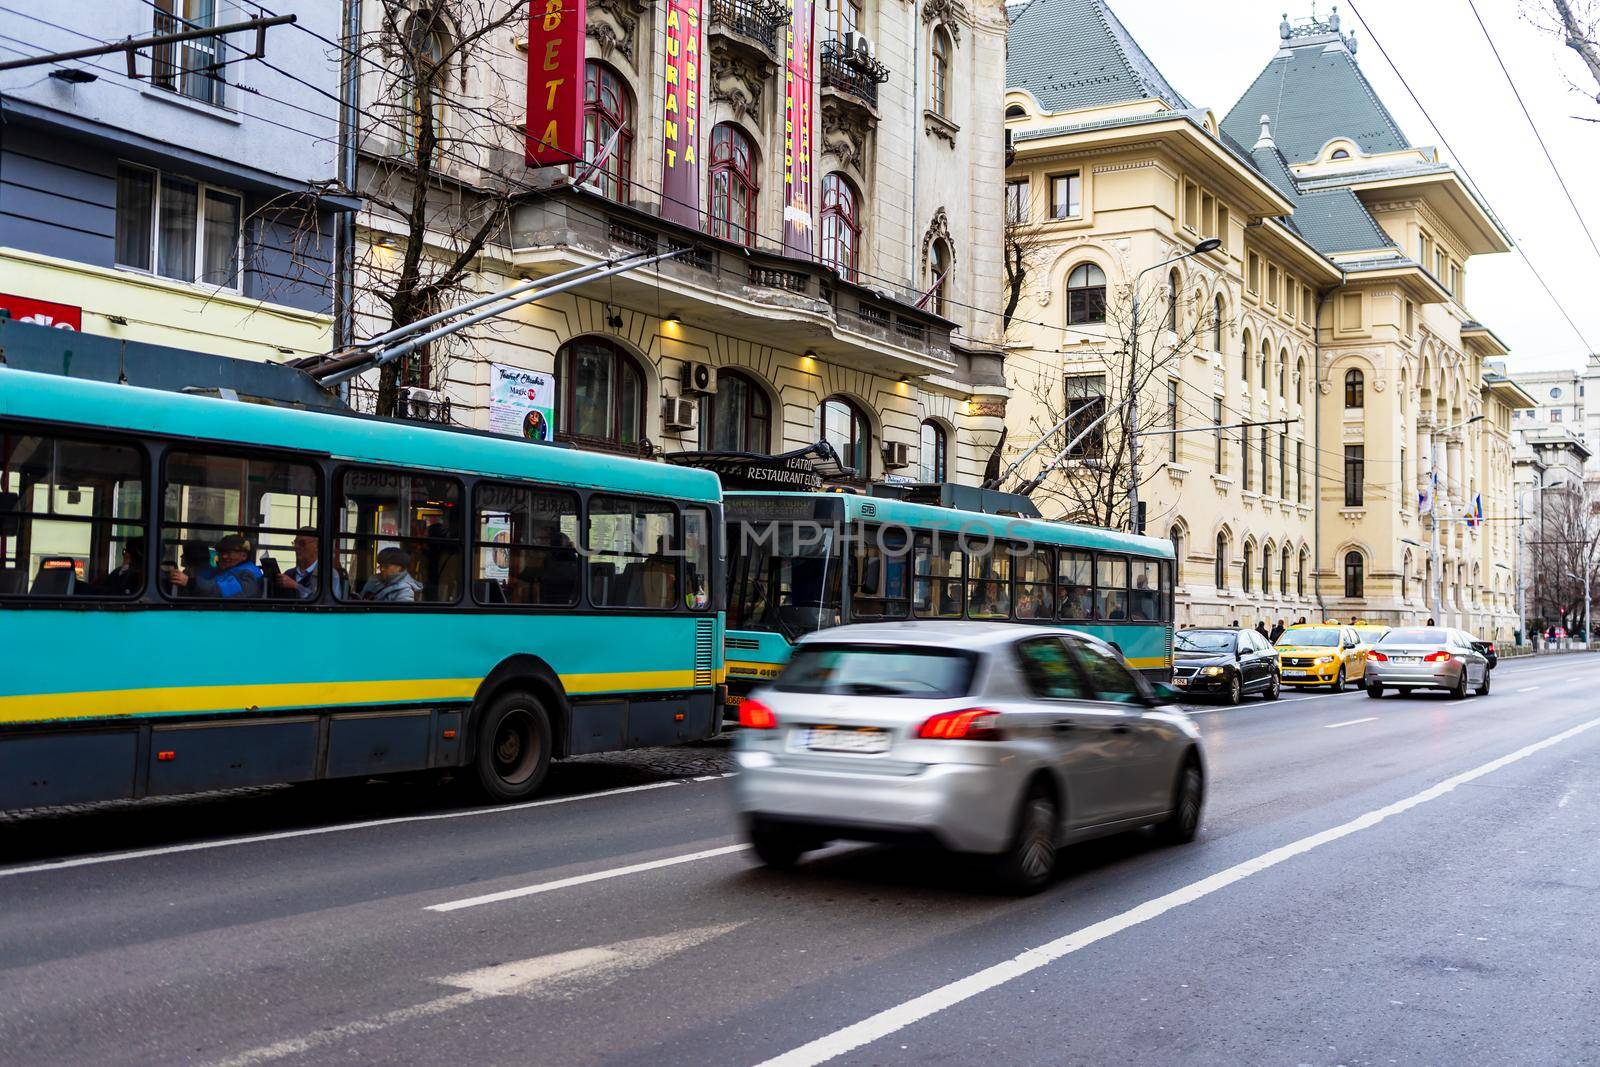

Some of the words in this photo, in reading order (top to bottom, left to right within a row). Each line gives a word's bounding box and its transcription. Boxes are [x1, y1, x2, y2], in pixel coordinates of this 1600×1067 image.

[510, 387, 527, 396] Magic
[747, 467, 805, 485] RESTAURANT
[861, 505, 875, 514] STB
